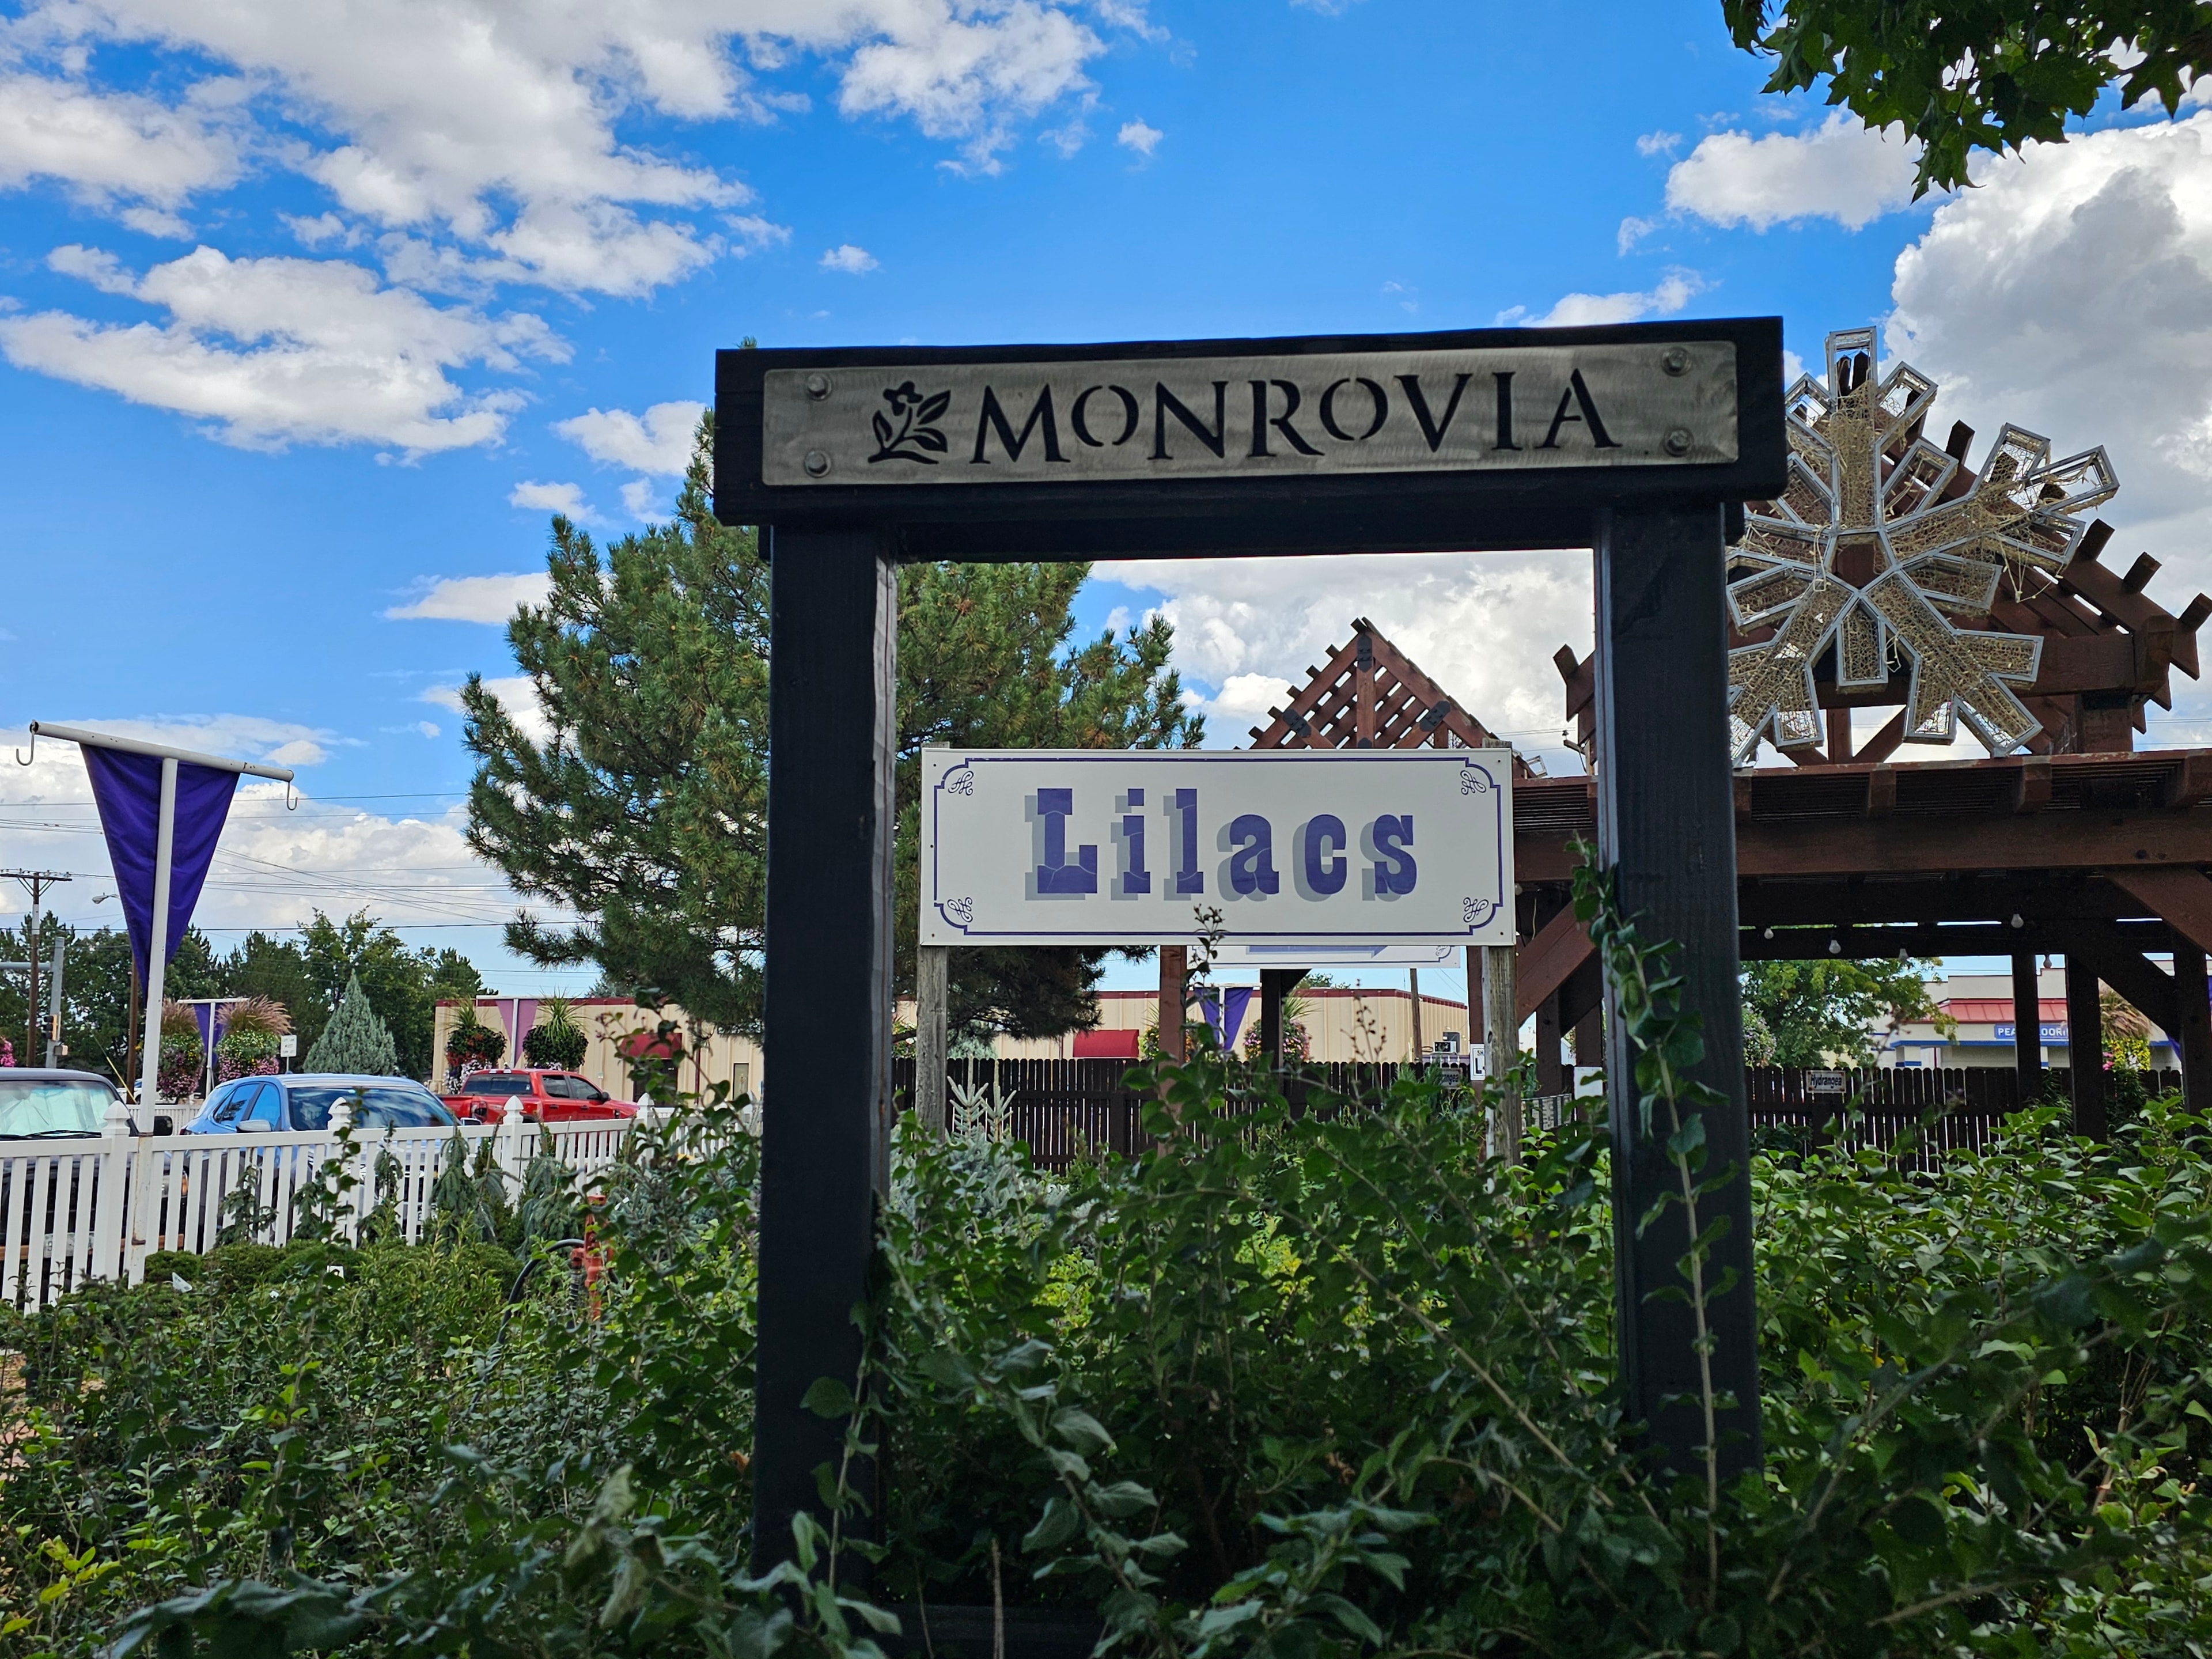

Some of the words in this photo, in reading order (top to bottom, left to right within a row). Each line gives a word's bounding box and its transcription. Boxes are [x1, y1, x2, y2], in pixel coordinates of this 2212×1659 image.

[969, 368, 1623, 463] MONROVIA
[1025, 788, 1417, 902] Lilacs
[1810, 1074, 1842, 1089] Hydrangea
